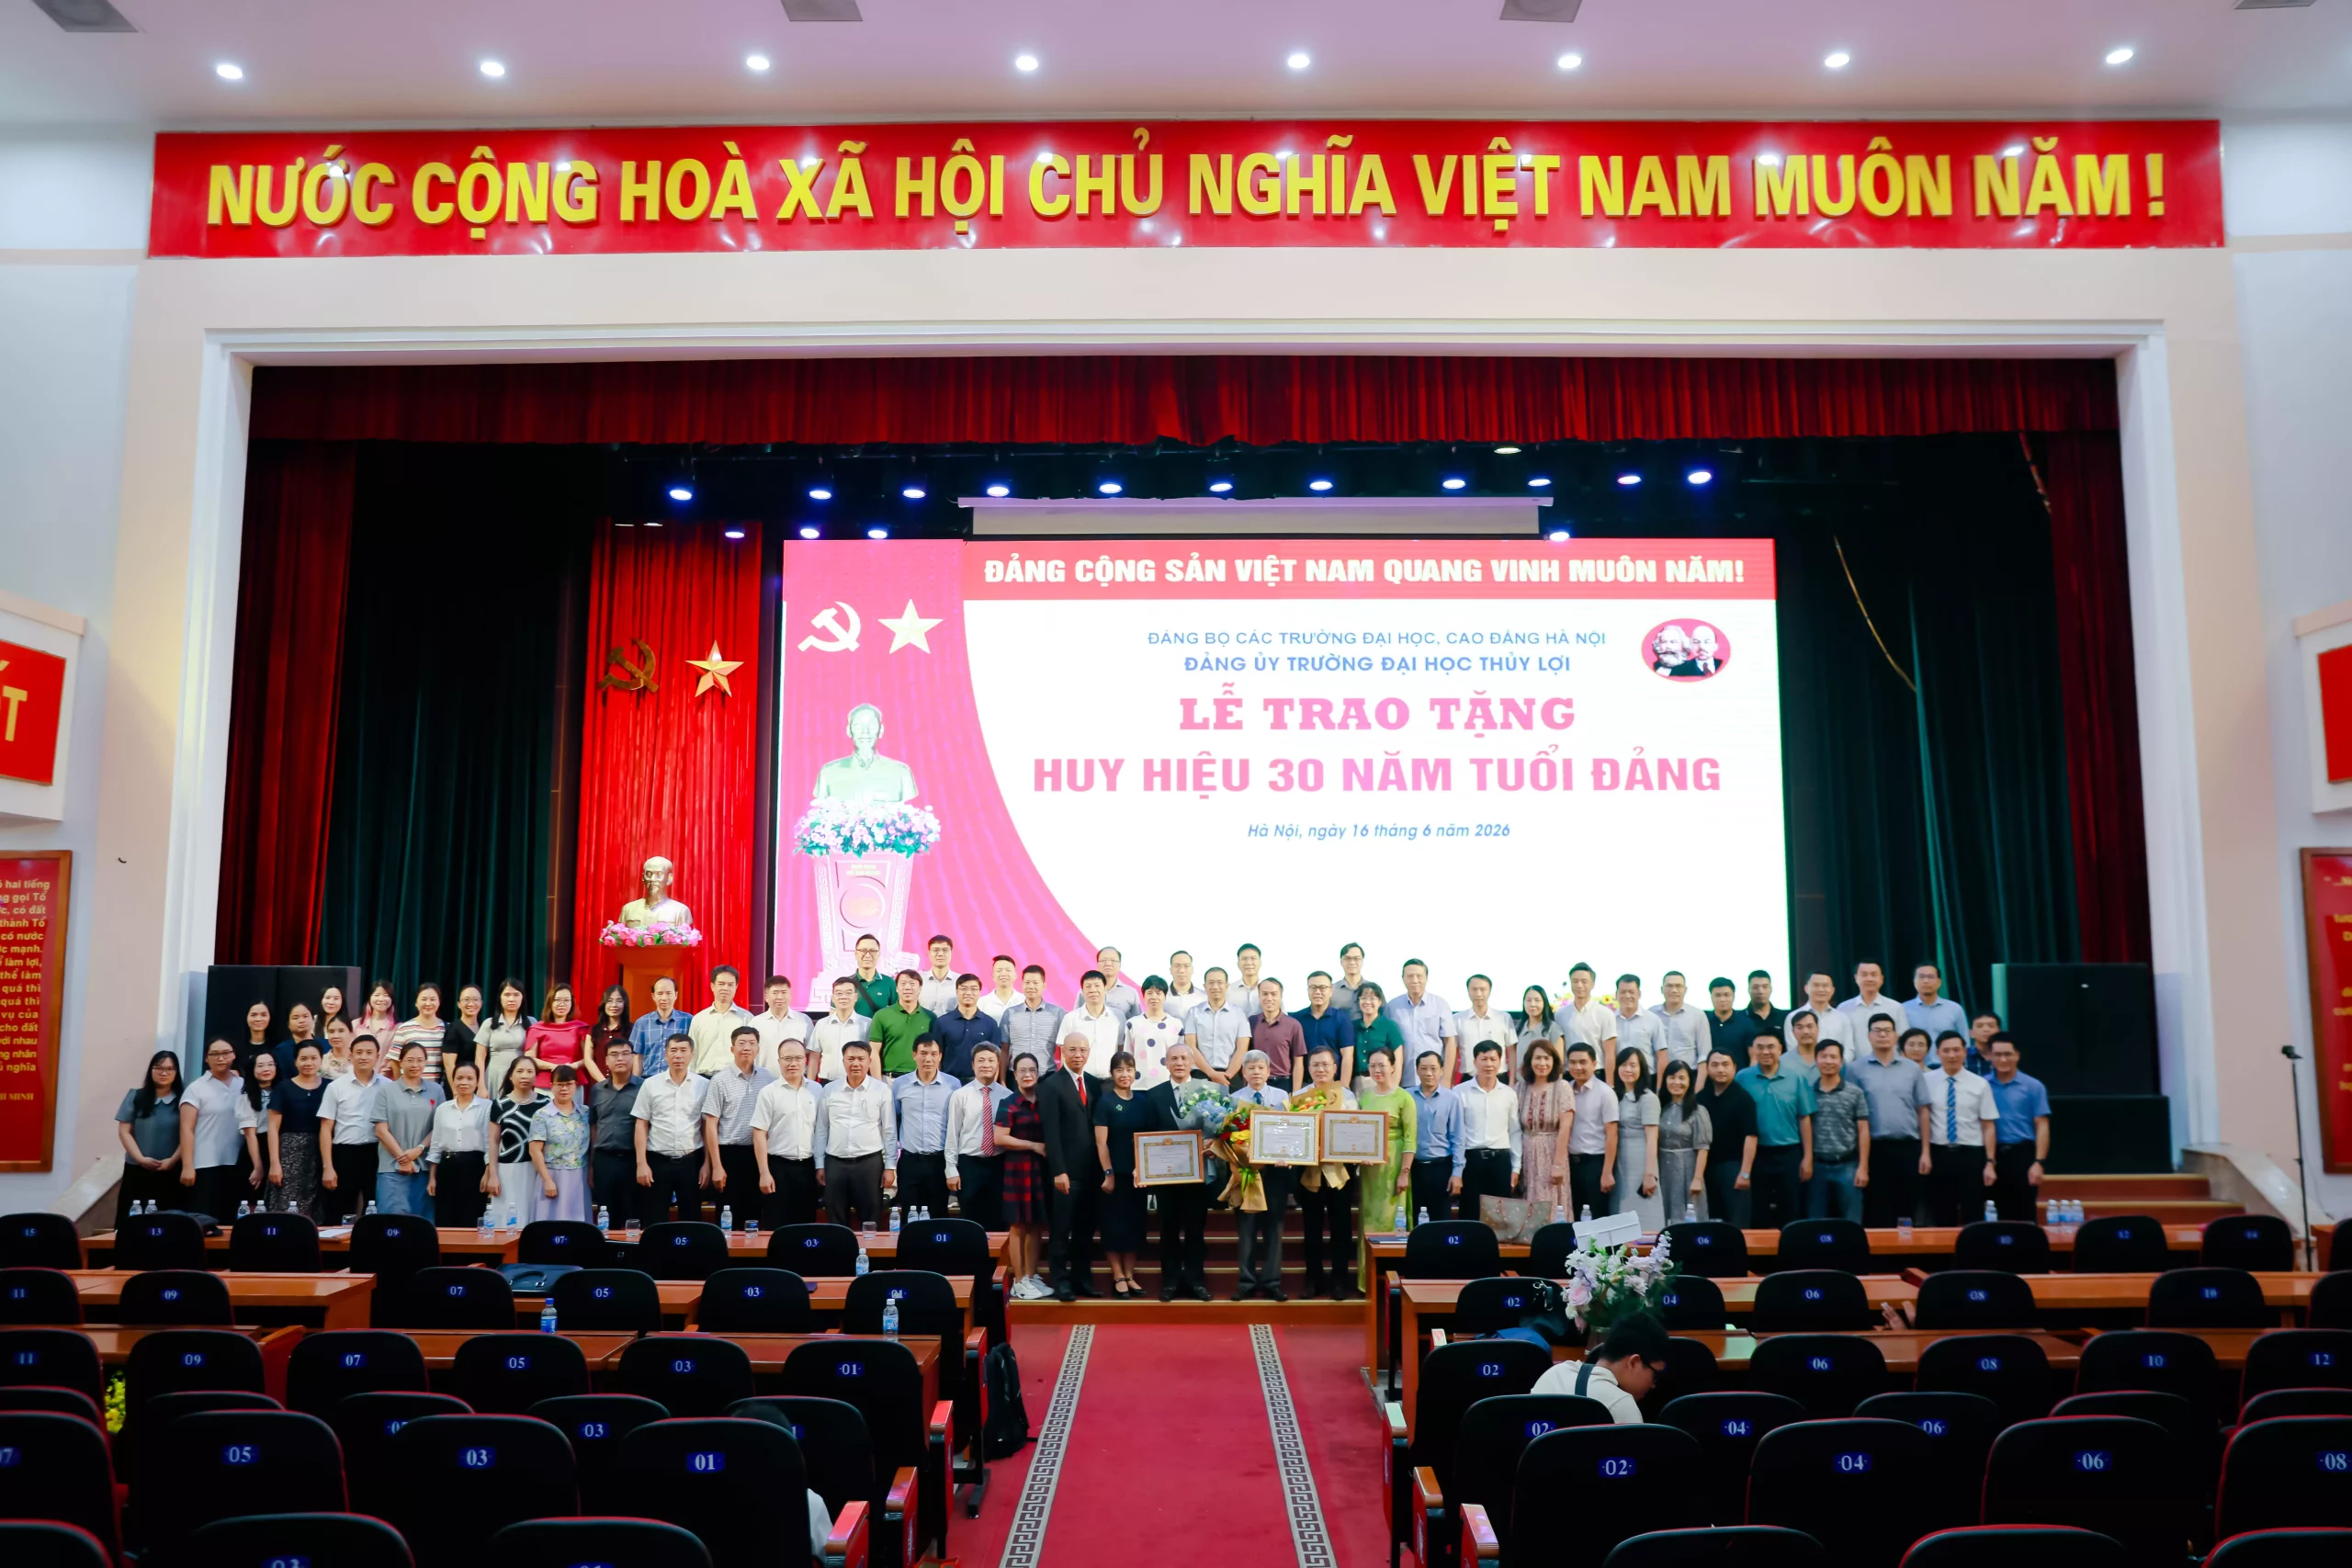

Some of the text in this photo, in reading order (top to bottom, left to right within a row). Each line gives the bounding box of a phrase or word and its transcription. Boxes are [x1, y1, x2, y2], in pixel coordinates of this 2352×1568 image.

[209, 146, 392, 225] NƯỚC
[413, 147, 596, 238] CỘNG
[621, 142, 756, 220] HOÀ
[776, 141, 873, 218] XÃ
[896, 140, 1004, 232] HỘI
[1029, 128, 1162, 217] CHỦ
[1190, 135, 1396, 214] NGHĨA
[1414, 138, 1560, 231] VIỆT
[1580, 156, 1730, 216] NAM
[1756, 138, 1951, 216] MUÔN
[985, 552, 1744, 586] ĐẢNG CỘNG SẢN VIỆT NAM QUANG VINH MUÔN NĂM!
[1236, 629, 1272, 644] CÁC
[1279, 629, 1356, 644] TRƯỜNG
[1363, 632, 1391, 647] ĐẠI
[1398, 633, 1440, 647] HỌC,
[1446, 633, 1484, 644] CAO
[1546, 629, 1569, 644] HÀ
[1184, 651, 1569, 675] ĐẢNG ỦY TRƯỜNG ĐẠI HỌC THỦY LỢI
[1180, 682, 1575, 739] LỄ TRAO TẶNG
[1035, 744, 1720, 799] HUY HIỆU 30 NĂM TUỔI ĐẢNG
[1248, 823, 1510, 840] Hà Nội, ngày 16 tháng 6 năm 2026
[6, 879, 21, 888] hai
[24, 878, 51, 891] tiếng
[12, 893, 29, 904] gọi
[13, 905, 26, 914] có
[2, 931, 44, 941] có nước
[10, 944, 43, 955] mạnh.
[2, 983, 23, 994] quá
[0, 996, 21, 1007] quá
[1, 1009, 39, 1021] vụ của
[13, 1036, 38, 1045] nhau
[152, 1227, 163, 1236] 13
[266, 1227, 277, 1235] 11
[387, 1228, 399, 1237] 09
[554, 1235, 565, 1245] 07
[675, 1236, 687, 1246] 05
[806, 1238, 818, 1247] 03
[935, 1234, 947, 1243] 01
[1448, 1235, 1460, 1245] 02
[1697, 1236, 1710, 1245] 06
[164, 1290, 177, 1300] 09
[449, 1285, 464, 1296] 07
[594, 1287, 609, 1298] 05
[747, 1287, 760, 1297] 03
[1805, 1289, 1820, 1300] 06
[1507, 1297, 1521, 1307] 02
[1662, 1294, 1677, 1305] 04
[185, 1353, 202, 1366] 09
[345, 1354, 361, 1366] 07
[508, 1357, 526, 1370] 05
[1812, 1358, 1828, 1370] 06
[1981, 1358, 1998, 1371] 08
[2148, 1355, 2164, 1367] 10
[2314, 1353, 2329, 1366] 12
[674, 1360, 692, 1372] 03
[841, 1363, 857, 1375] 01
[1482, 1364, 1499, 1376] 02
[583, 1423, 604, 1438] 03
[1727, 1421, 1747, 1436] 04
[1923, 1420, 1942, 1434] 06
[229, 1446, 252, 1463] 05
[466, 1449, 488, 1466] 03
[695, 1453, 716, 1471] 01
[1840, 1454, 1864, 1471] 04
[2082, 1452, 2105, 1470] 06
[2324, 1452, 2347, 1471] 08
[1605, 1459, 1628, 1476] 02
